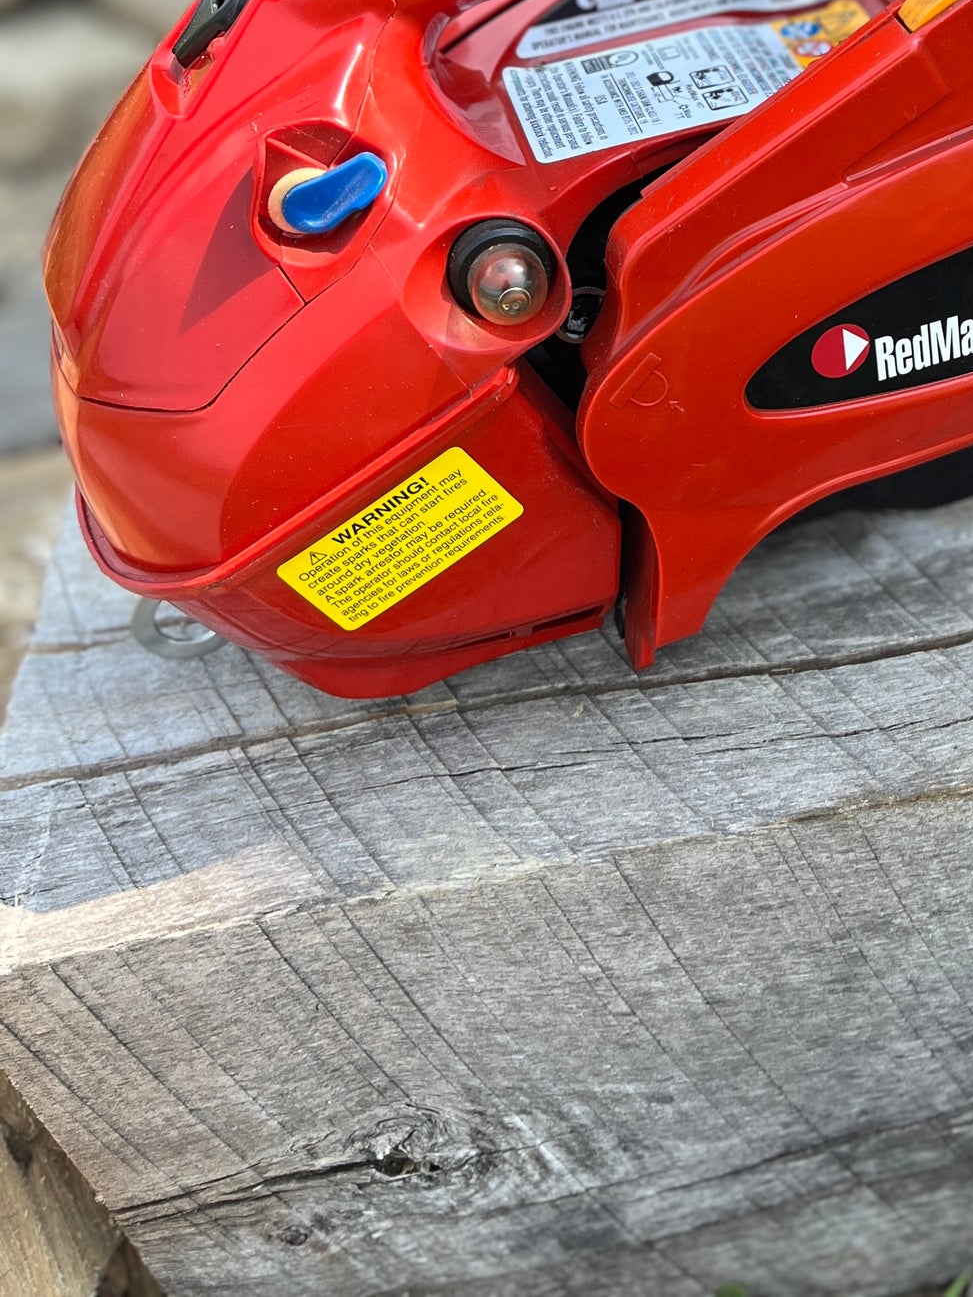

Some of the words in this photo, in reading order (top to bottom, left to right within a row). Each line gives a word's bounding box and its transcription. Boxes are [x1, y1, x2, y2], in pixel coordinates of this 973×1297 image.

[298, 546, 352, 582] Operation
[351, 536, 363, 548] of
[362, 524, 384, 539] this
[384, 485, 439, 525] equipment
[438, 469, 462, 488] may
[308, 566, 342, 589] create
[341, 541, 378, 567] sparks
[376, 526, 399, 543] that
[399, 512, 420, 528] can
[419, 494, 444, 514] start
[442, 478, 468, 496] fires
[331, 476, 430, 545] WARNING!
[331, 595, 353, 609] The
[353, 567, 392, 596] operator
[392, 545, 425, 570] should
[424, 521, 460, 548] contact
[457, 504, 483, 524] local
[480, 494, 499, 507] fire
[316, 568, 354, 596] around
[353, 557, 372, 571] dry
[325, 594, 336, 603] A
[334, 575, 365, 596] spark
[365, 547, 404, 577] arrestor
[405, 531, 428, 549] may
[427, 521, 444, 533] be
[341, 587, 384, 617] agencies
[382, 577, 398, 588] for
[396, 562, 421, 578] laws
[420, 553, 431, 563] or
[432, 518, 483, 555] regulations
[482, 503, 504, 520] rela-
[348, 608, 370, 623] ting
[366, 602, 379, 611] to
[377, 590, 395, 603] fire
[395, 557, 444, 594] prevention
